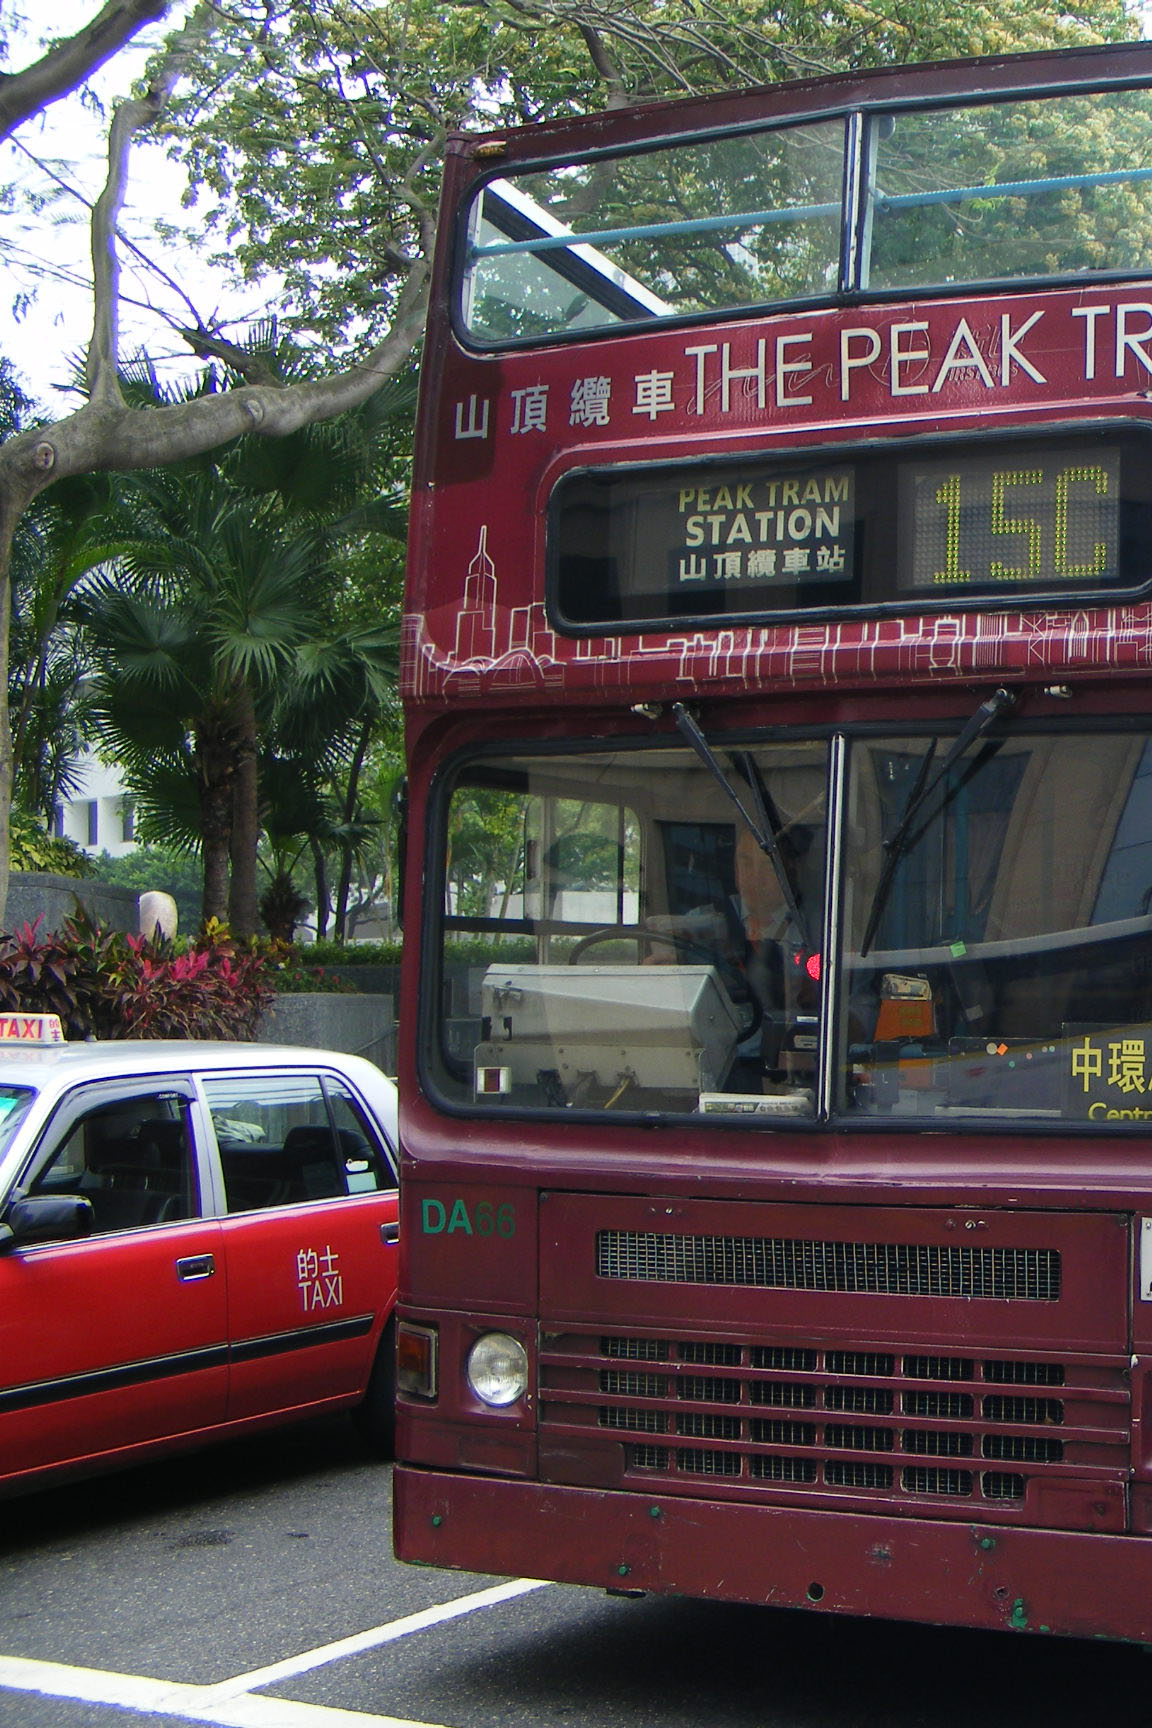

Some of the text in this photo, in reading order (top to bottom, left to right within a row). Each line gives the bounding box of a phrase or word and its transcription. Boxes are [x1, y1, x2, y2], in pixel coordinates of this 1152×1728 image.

[685, 332, 813, 415] THE
[840, 310, 1048, 401] PEAK
[455, 369, 675, 439] 山頂纜車
[678, 476, 849, 513] PEAK TRAM
[685, 506, 840, 547] STATION
[933, 465, 1108, 584] 15C
[679, 544, 846, 582] 山頂纜車站
[0, 1018, 43, 1038] TAXI
[422, 1199, 516, 1239] DA66
[297, 1245, 339, 1280] 的士
[298, 1276, 343, 1312] TAXI
